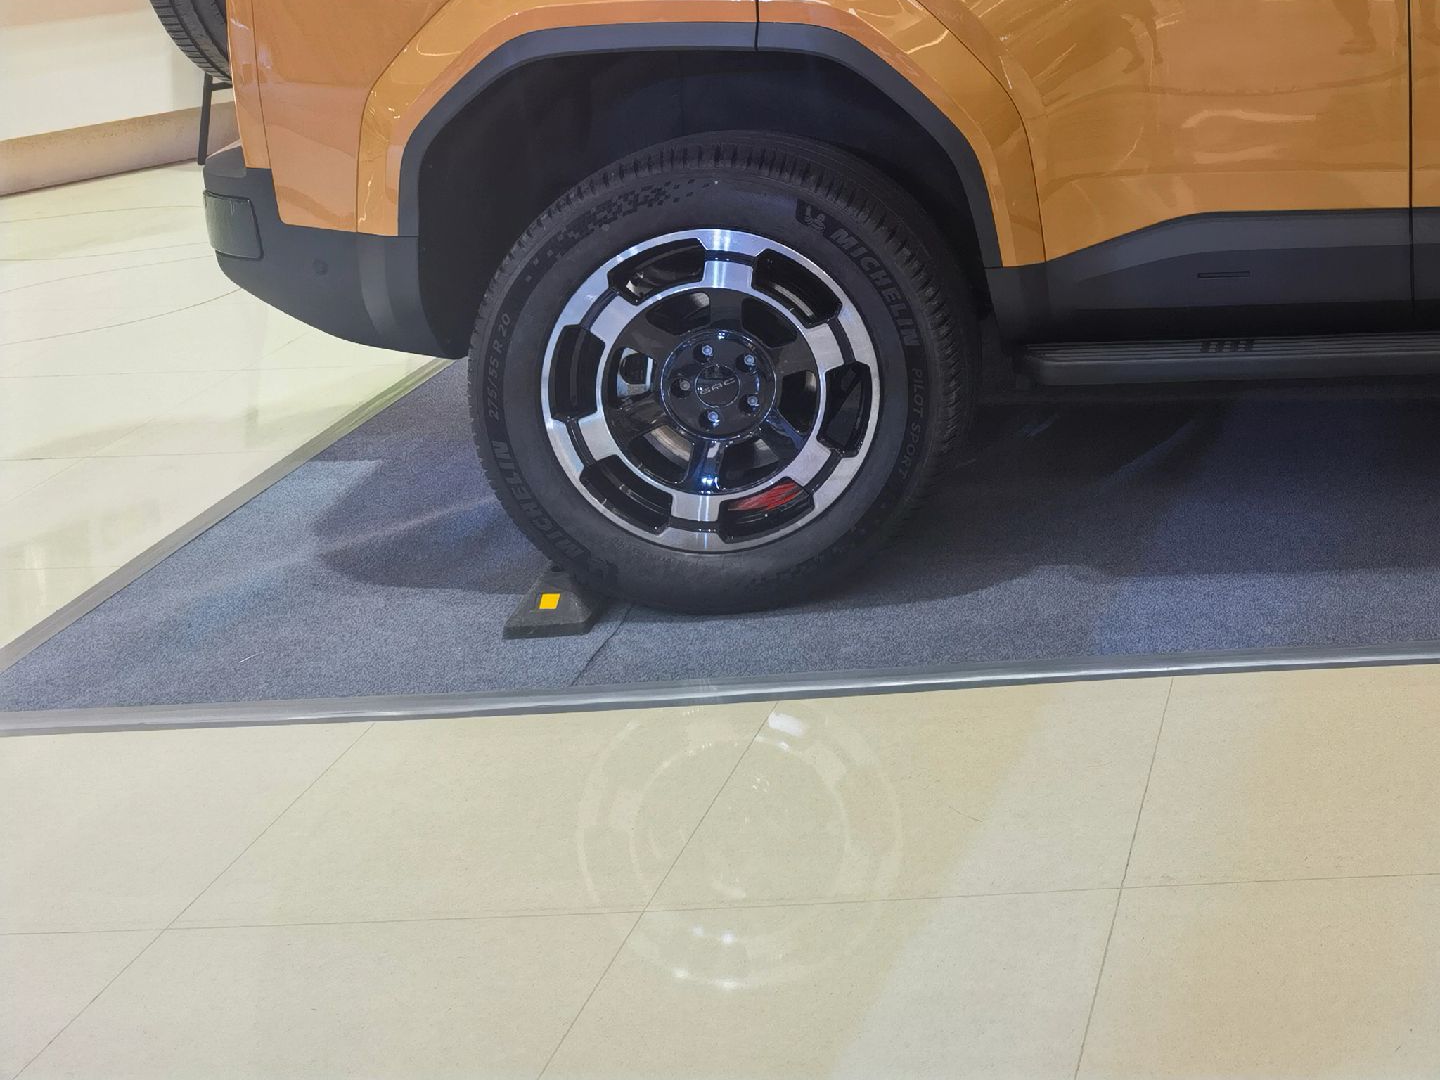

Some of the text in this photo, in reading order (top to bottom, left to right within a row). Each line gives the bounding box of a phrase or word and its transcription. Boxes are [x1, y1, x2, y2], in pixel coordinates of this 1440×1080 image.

[497, 312, 512, 338] 20
[829, 226, 925, 483] MICHELIN PILOT SPORT
[490, 439, 587, 562] MICHELIN
